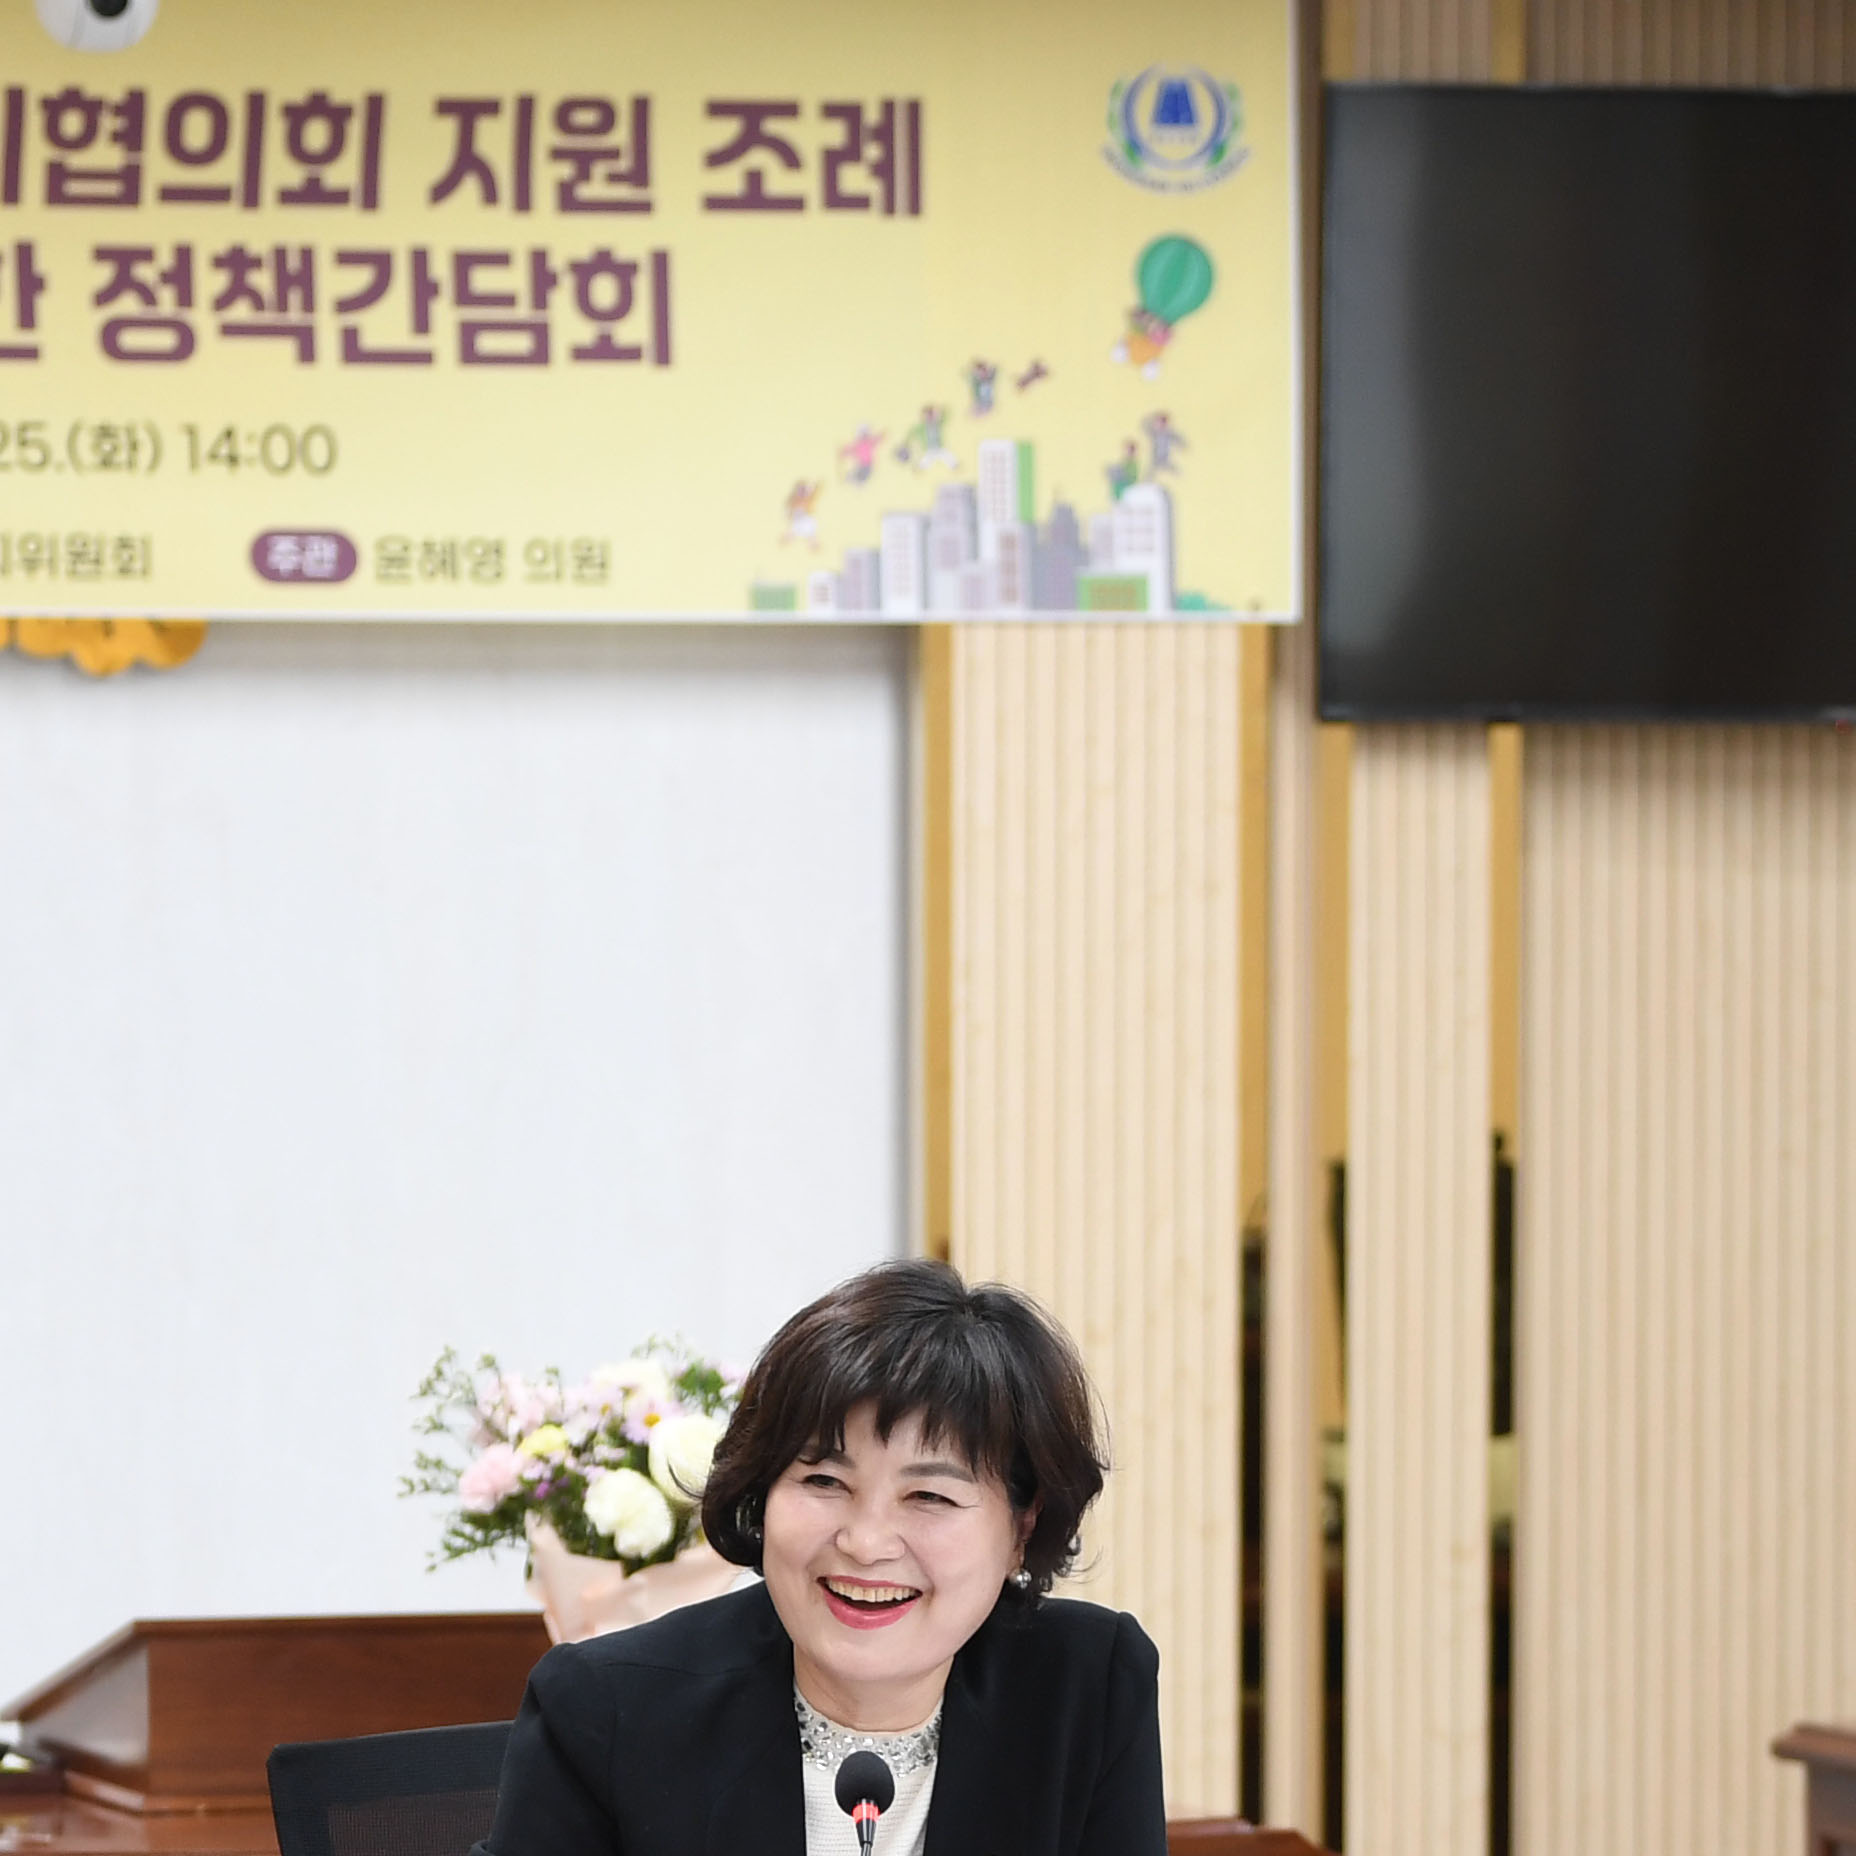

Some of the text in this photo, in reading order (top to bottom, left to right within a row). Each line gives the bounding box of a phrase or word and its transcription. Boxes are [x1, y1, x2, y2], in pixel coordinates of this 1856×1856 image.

[429, 92, 655, 216] 지원
[702, 97, 925, 219] 조례
[91, 243, 673, 368] 정책간담회
[181, 422, 340, 478] 14:00
[372, 534, 508, 587] 윤혜영
[522, 537, 614, 587] 의원
